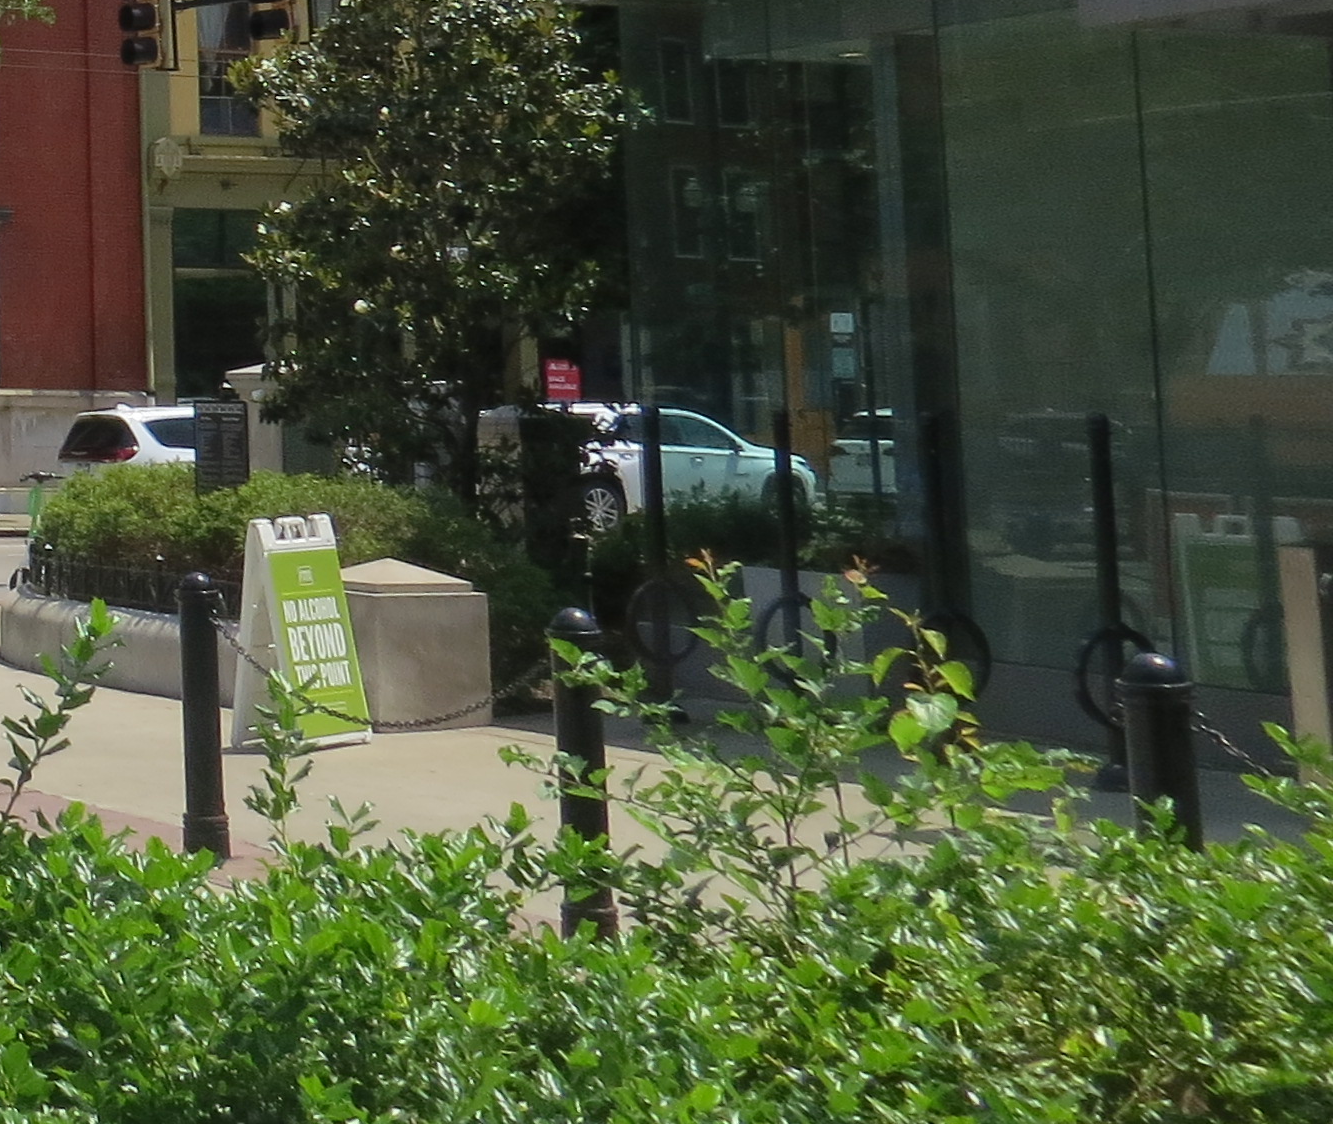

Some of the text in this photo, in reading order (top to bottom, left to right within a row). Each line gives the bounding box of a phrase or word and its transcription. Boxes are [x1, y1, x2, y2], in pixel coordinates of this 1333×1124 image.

[282, 596, 341, 623] NO ALCOHOL
[287, 622, 347, 663] BEYOND
[294, 660, 353, 689] THIS POINT
